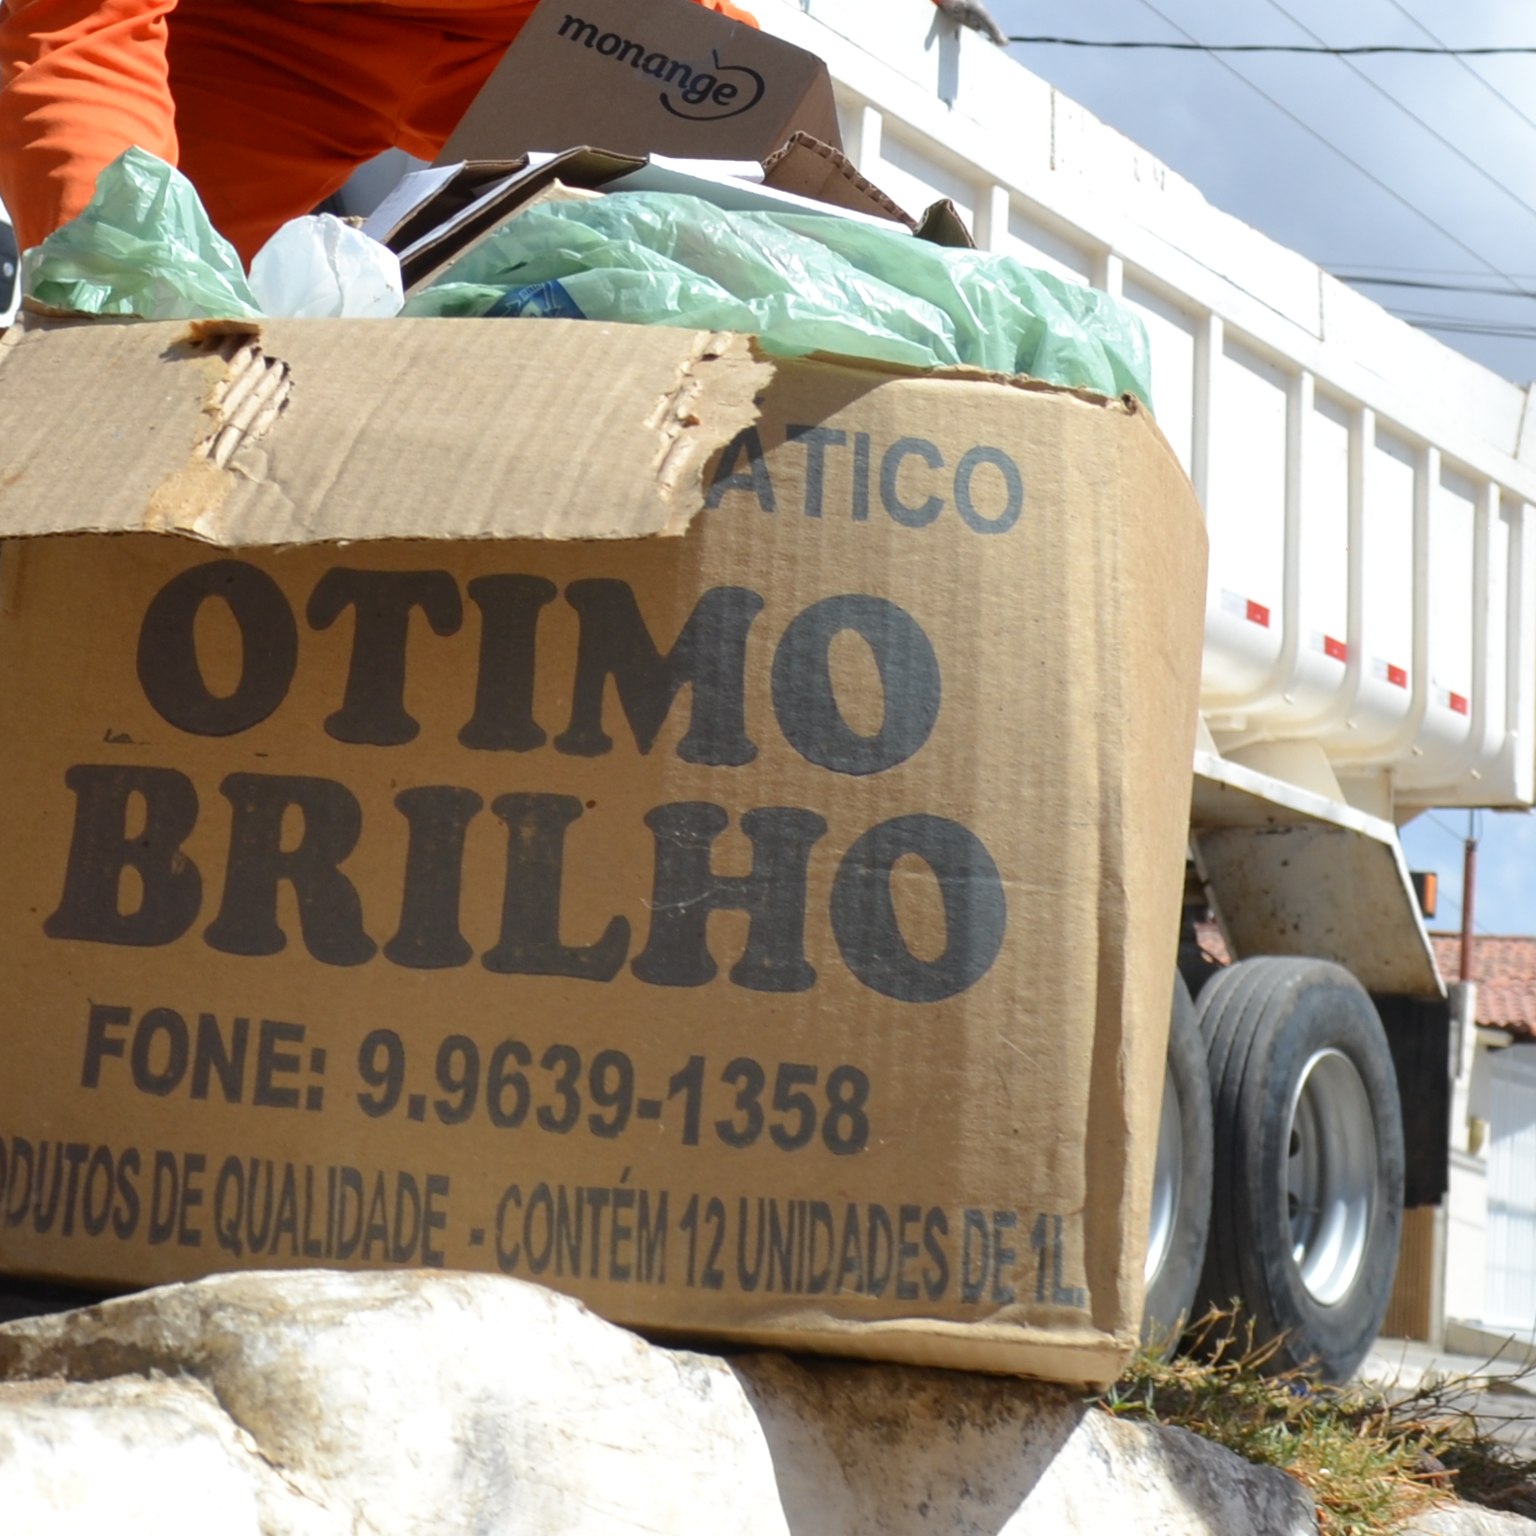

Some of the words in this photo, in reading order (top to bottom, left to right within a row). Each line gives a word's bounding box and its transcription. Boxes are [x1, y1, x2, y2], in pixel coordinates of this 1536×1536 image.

[557, 13, 744, 108] monange
[704, 422, 1025, 535] ATICO
[134, 557, 944, 778] OTIMO
[42, 762, 1009, 1005] BRILHO
[80, 1002, 328, 1113] FONE:
[356, 1028, 872, 1157] 9.9639-1358
[148, 1149, 207, 1248] DE
[214, 1153, 451, 1270] QUALIDADE
[494, 1166, 670, 1285] CONTÉM
[679, 1193, 728, 1291] 12
[736, 1196, 950, 1302] UNIDADES
[961, 1207, 1019, 1305] DE
